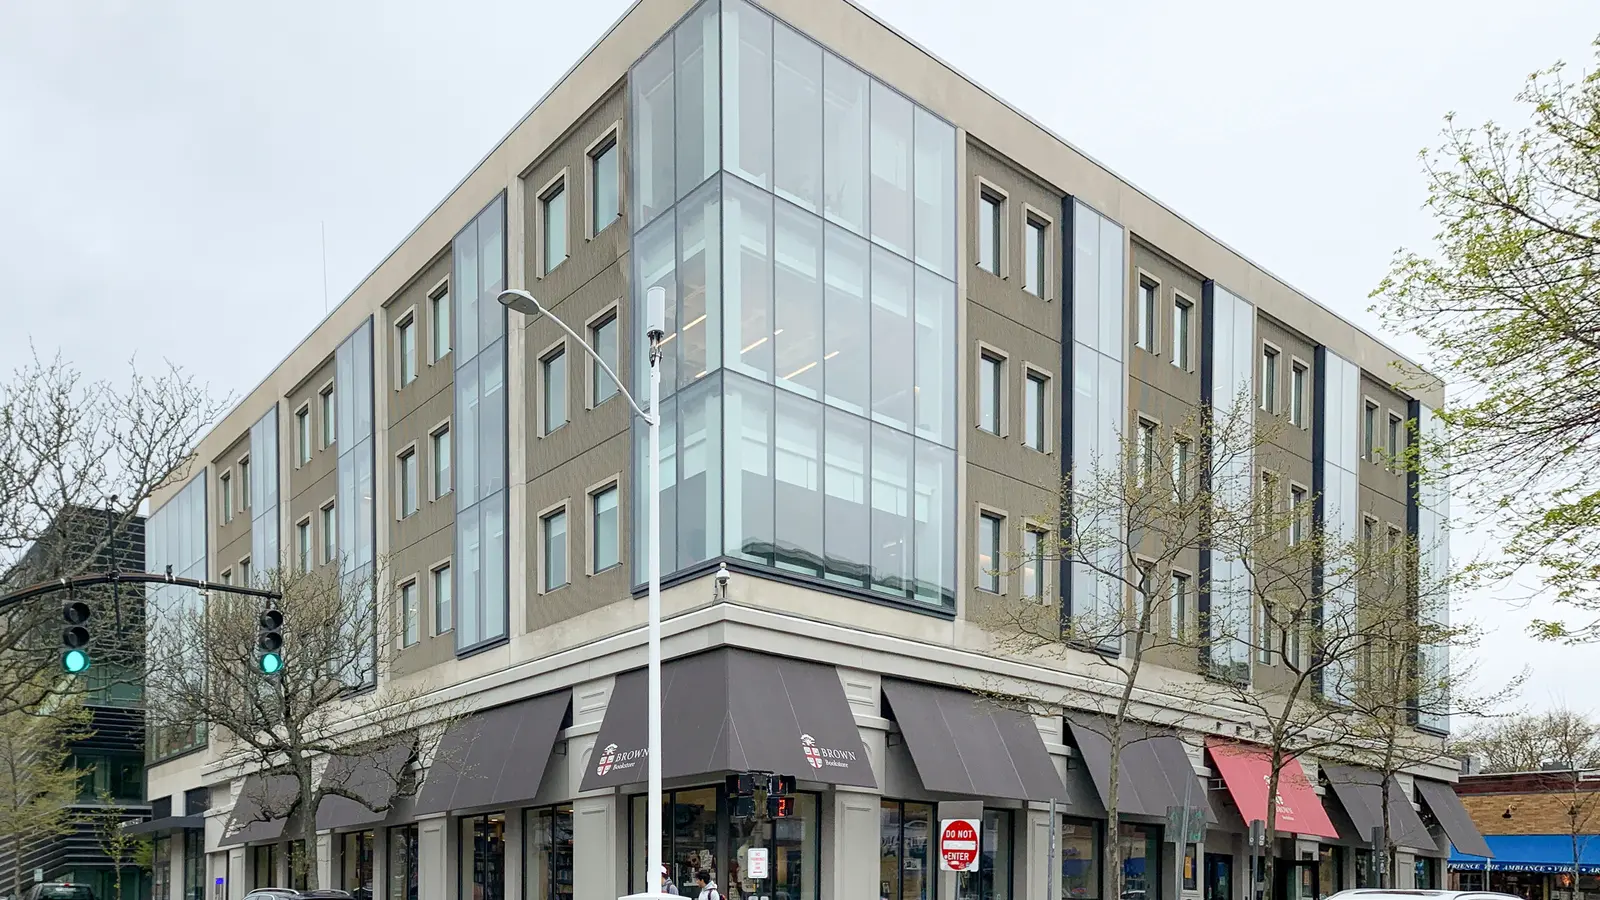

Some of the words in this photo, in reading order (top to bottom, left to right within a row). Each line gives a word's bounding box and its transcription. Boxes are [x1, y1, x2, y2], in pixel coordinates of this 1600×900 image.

[615, 748, 649, 762] BROWN
[820, 747, 857, 761] BROWN
[613, 762, 636, 771] Bookstore
[824, 759, 849, 769] Bookstore
[945, 829, 956, 839] DO
[957, 829, 973, 839] NOT
[947, 851, 970, 861] ENTER
